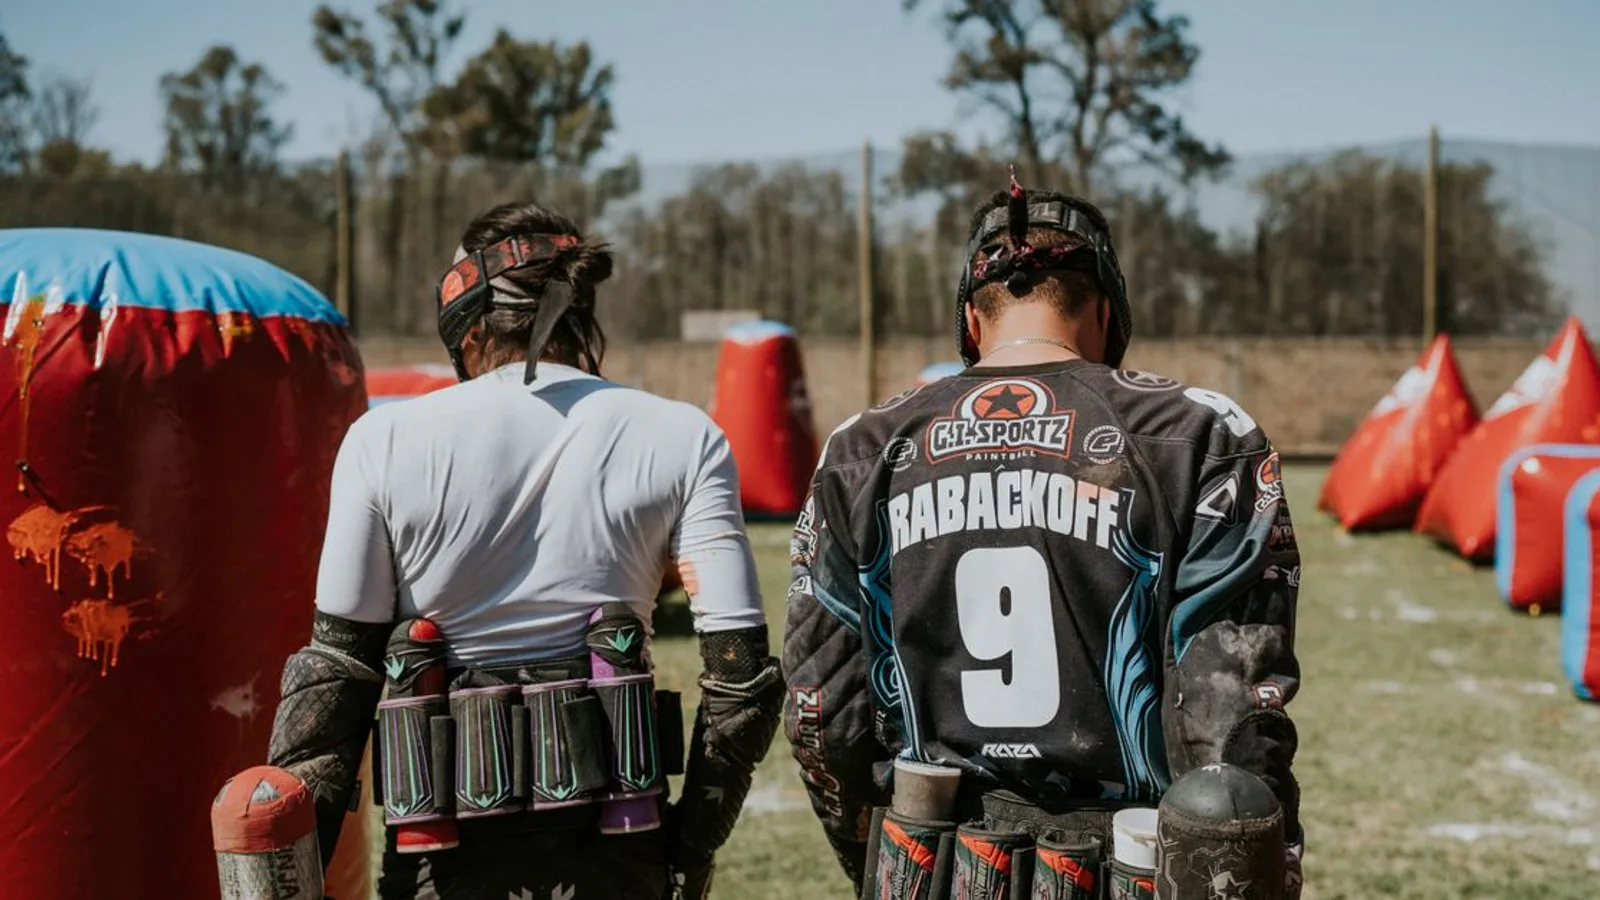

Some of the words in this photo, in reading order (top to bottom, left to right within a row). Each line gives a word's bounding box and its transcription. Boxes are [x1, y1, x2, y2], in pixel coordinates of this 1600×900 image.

[888, 469, 1120, 556] RABACKOFF
[955, 545, 1061, 728] 9
[981, 743, 1042, 758] RAZA
